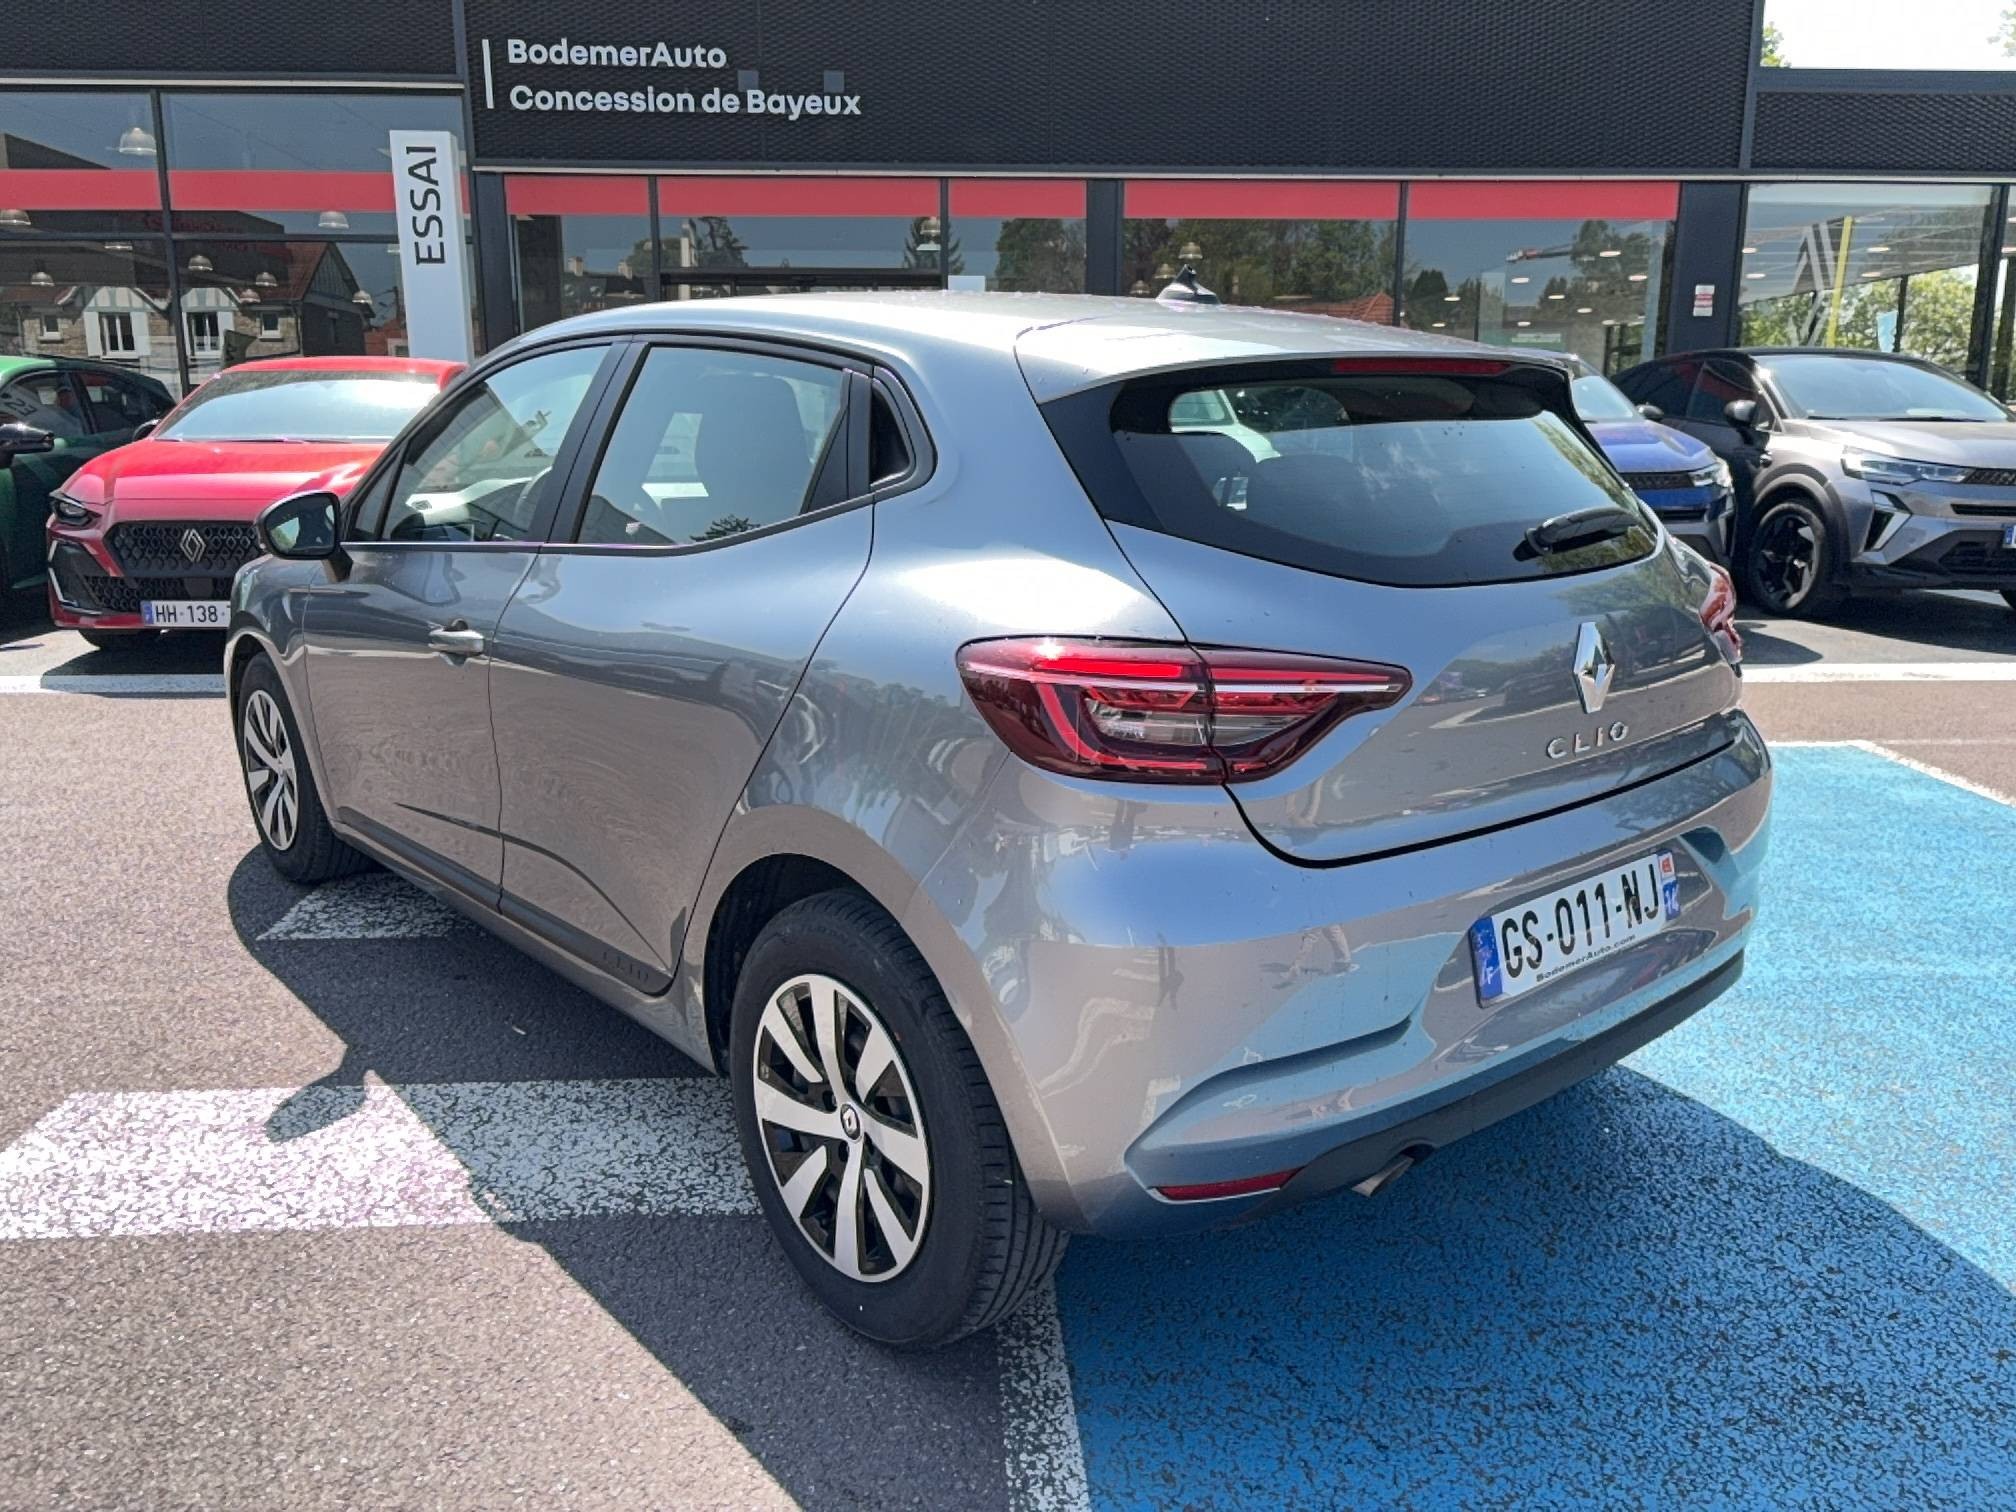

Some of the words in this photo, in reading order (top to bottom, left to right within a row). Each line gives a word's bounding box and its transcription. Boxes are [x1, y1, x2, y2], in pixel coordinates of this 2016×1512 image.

[507, 37, 728, 68] BodemerAuto
[510, 85, 695, 113] Concession
[701, 87, 740, 113] de
[747, 89, 862, 121] Bayeux
[406, 146, 446, 265] ESSAI
[155, 604, 231, 623] HH-138-
[1547, 721, 1629, 759] CLIO
[1502, 864, 1659, 978] GS-011-NJ
